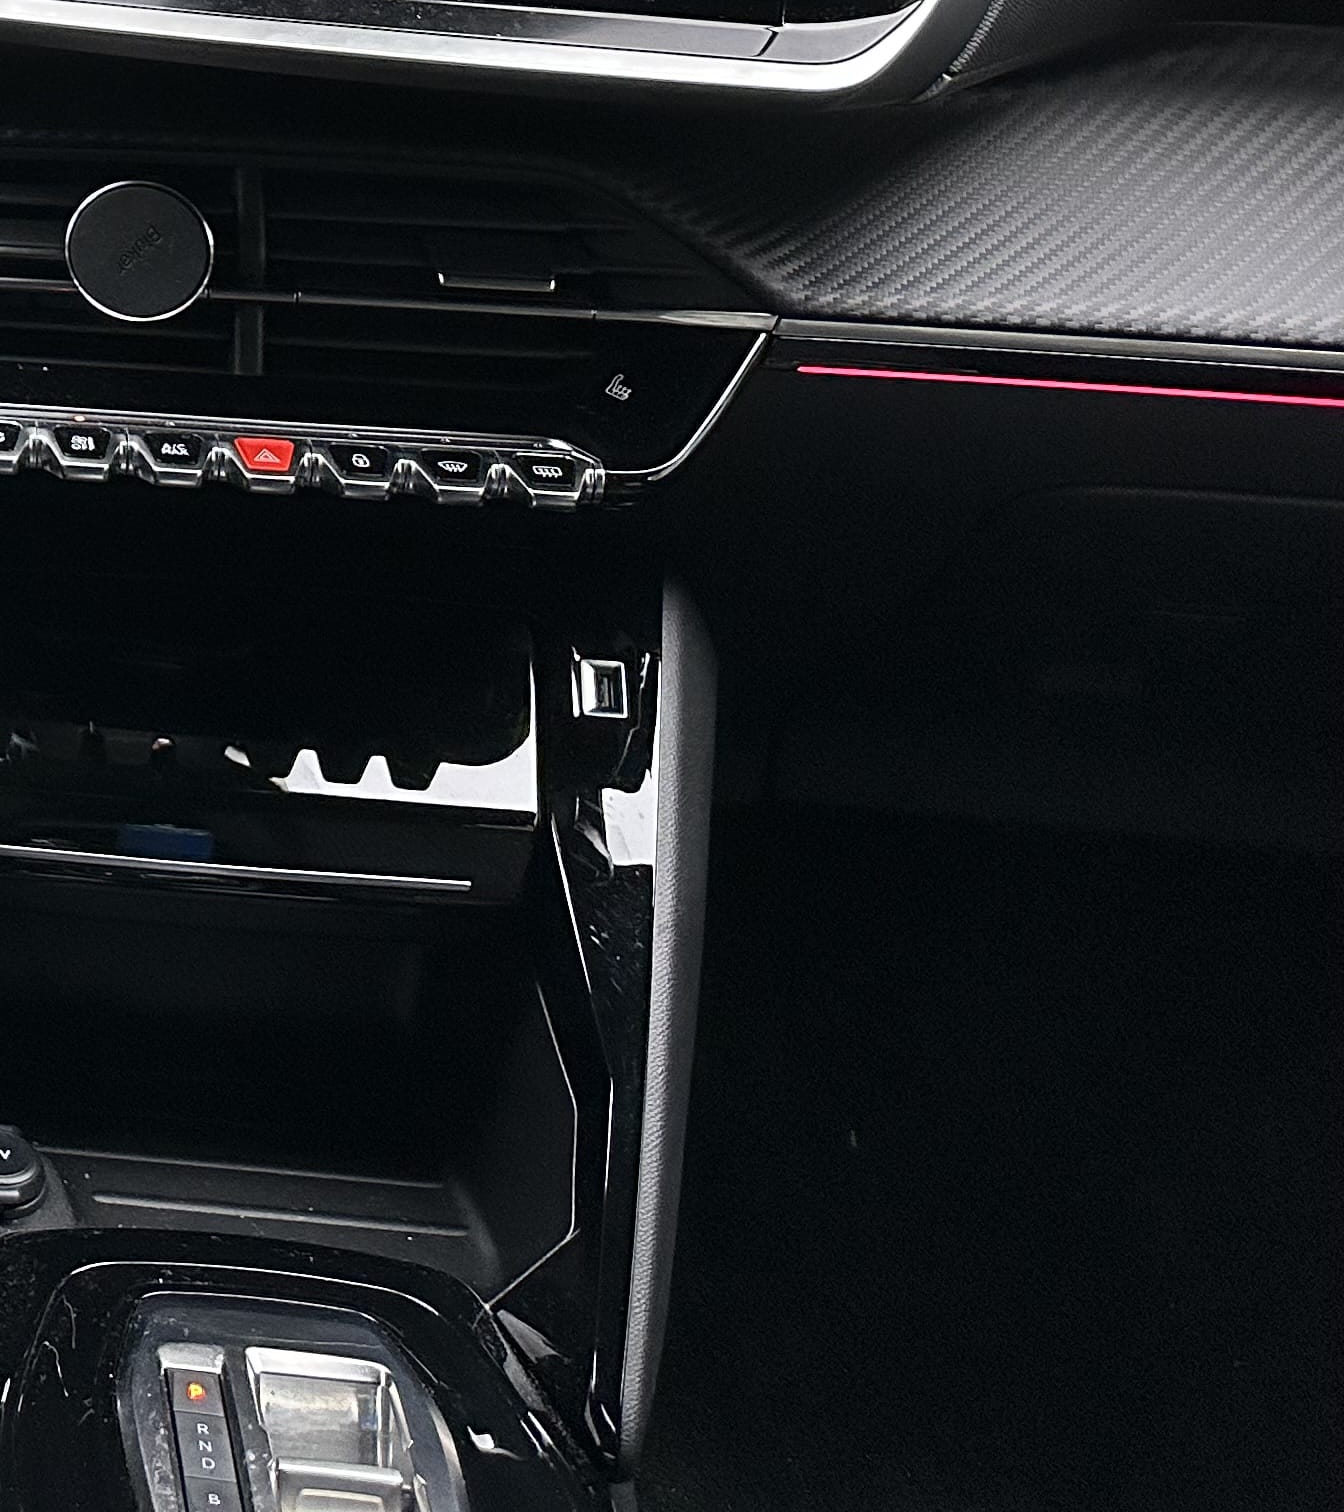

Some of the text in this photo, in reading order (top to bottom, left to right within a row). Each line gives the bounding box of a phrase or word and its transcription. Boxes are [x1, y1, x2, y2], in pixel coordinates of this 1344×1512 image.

[188, 1382, 205, 1400] P
[197, 1423, 210, 1435] R
[198, 1439, 213, 1453] N
[201, 1456, 216, 1469] D
[208, 1493, 221, 1506] B
